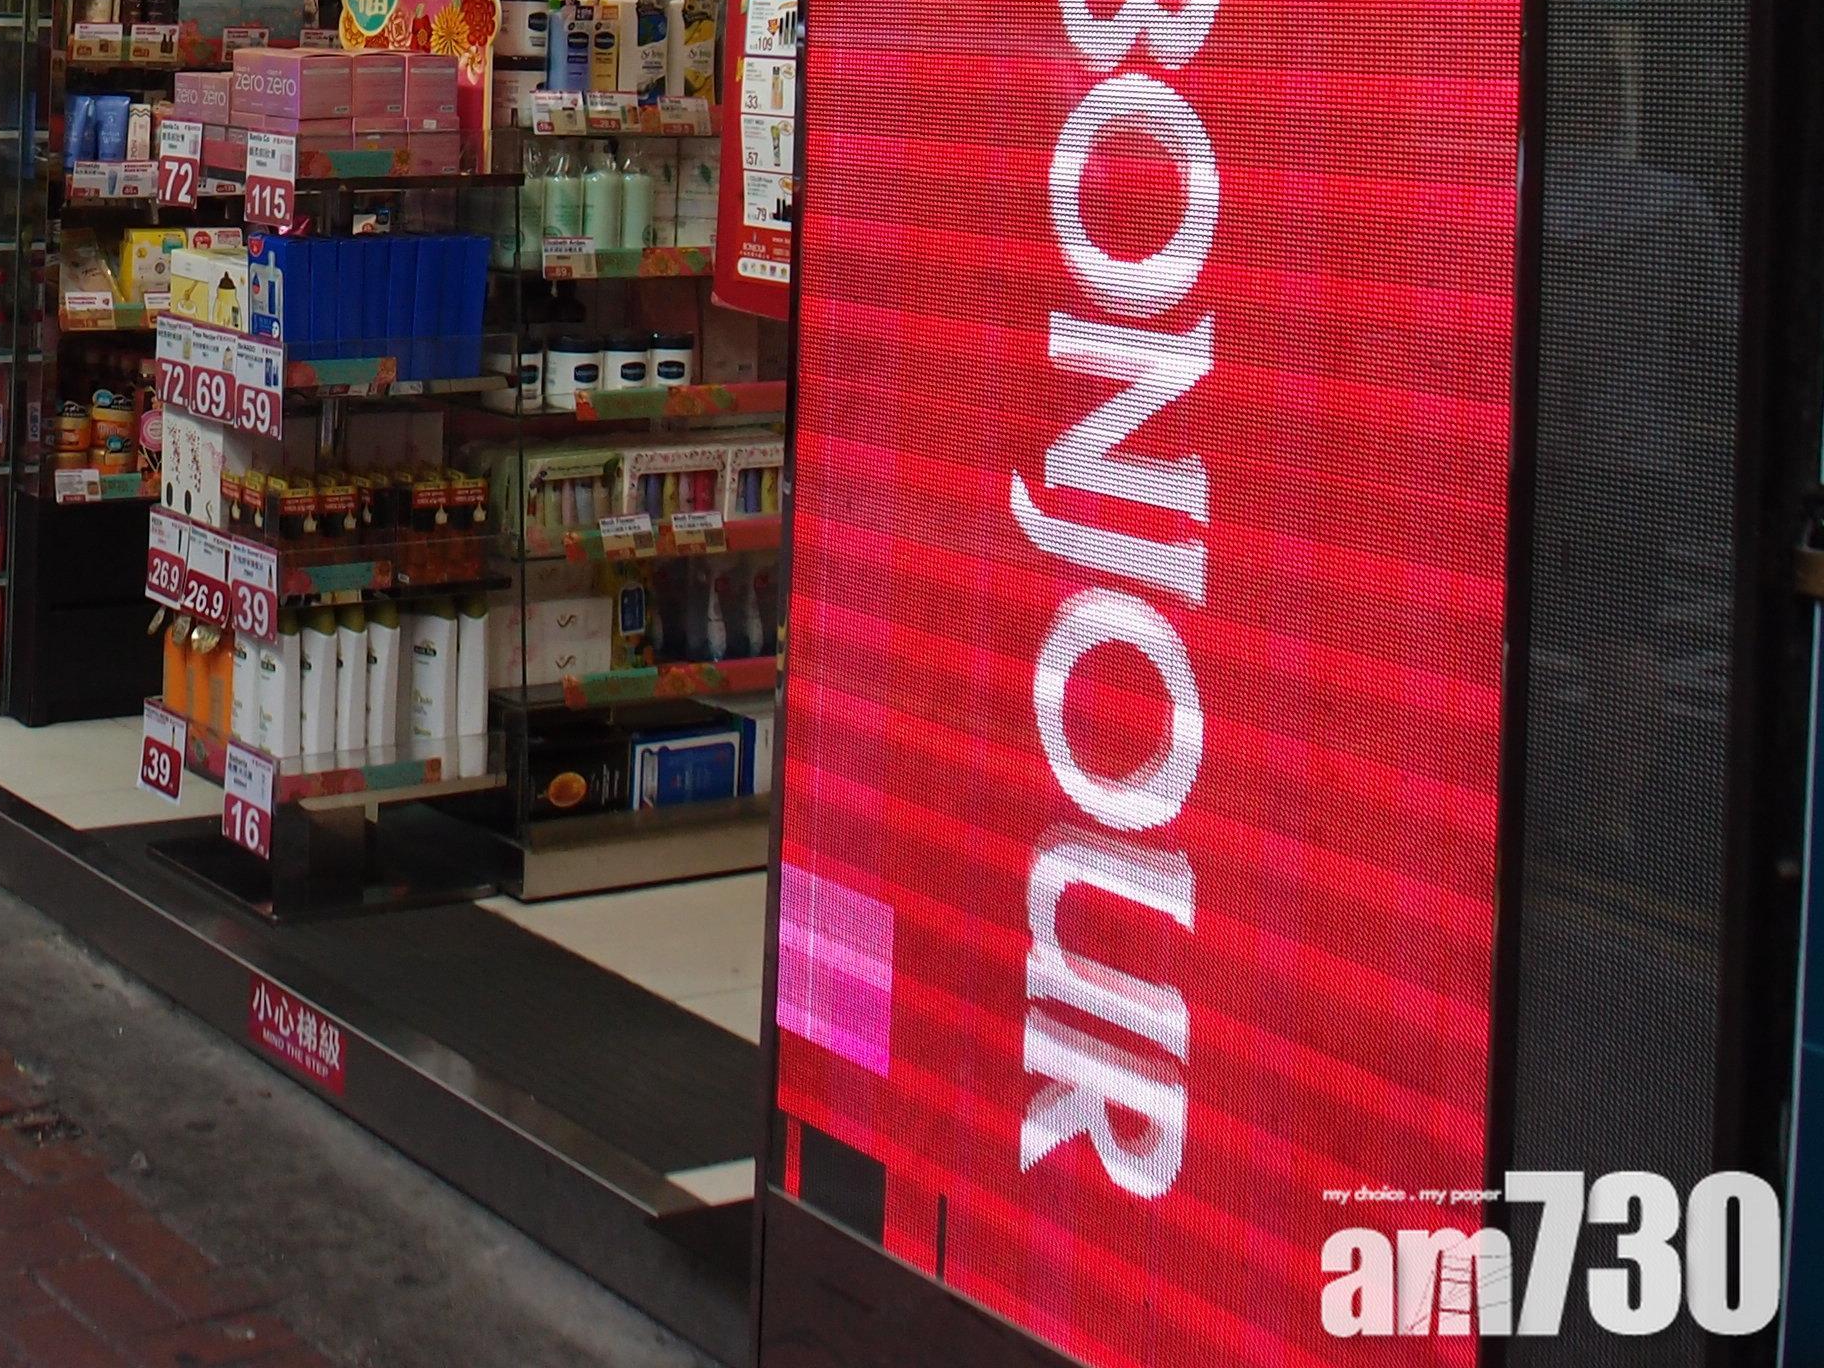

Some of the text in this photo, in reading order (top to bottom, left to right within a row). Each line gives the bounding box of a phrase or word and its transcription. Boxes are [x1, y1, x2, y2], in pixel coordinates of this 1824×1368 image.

[175, 87, 198, 105] zero
[201, 89, 226, 107] zero
[235, 71, 265, 92] zero
[266, 75, 298, 97] zero
[183, 579, 224, 620] 26.9
[238, 586, 269, 637] 39
[147, 747, 171, 786] 39
[231, 799, 260, 851] 16
[252, 982, 340, 1070] 小心梯級
[262, 1027, 330, 1079] MIND THE STEP
